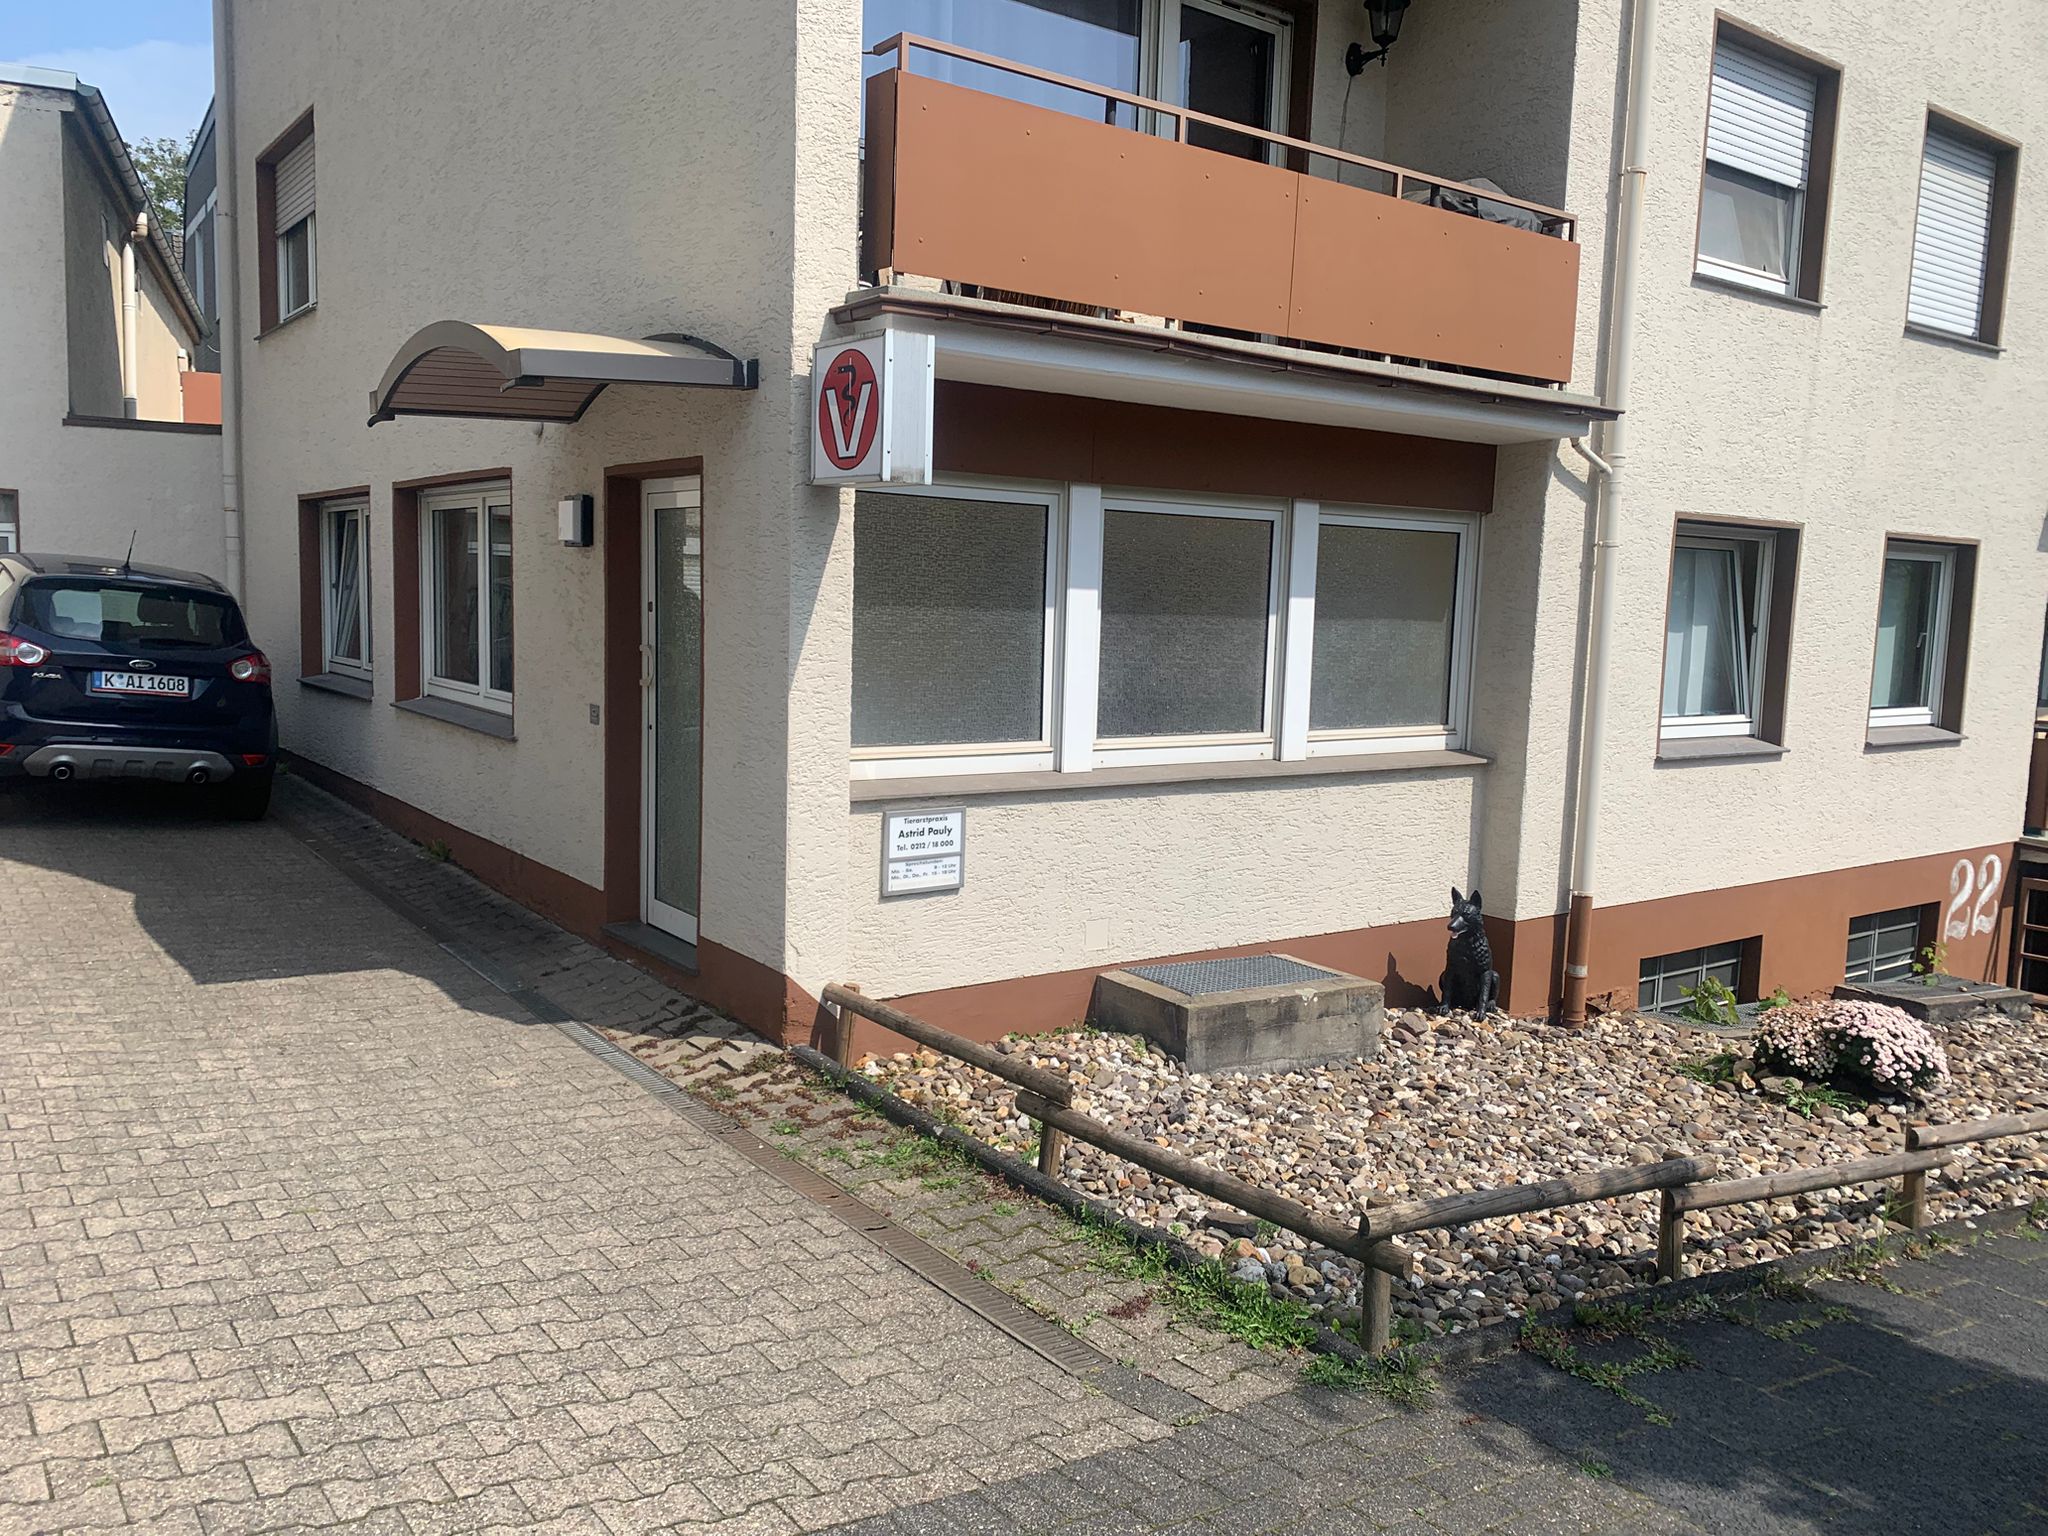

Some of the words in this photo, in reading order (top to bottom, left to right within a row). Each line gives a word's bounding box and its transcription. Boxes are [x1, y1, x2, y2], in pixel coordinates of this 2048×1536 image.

[825, 381, 873, 459] V
[104, 674, 115, 687] K
[126, 675, 146, 689] AI
[147, 677, 185, 691] 1608
[898, 827, 925, 839] Astrid
[928, 825, 952, 837] Pauly
[910, 841, 926, 850] 0212
[940, 839, 954, 847] 000
[1943, 853, 2002, 943] 22
